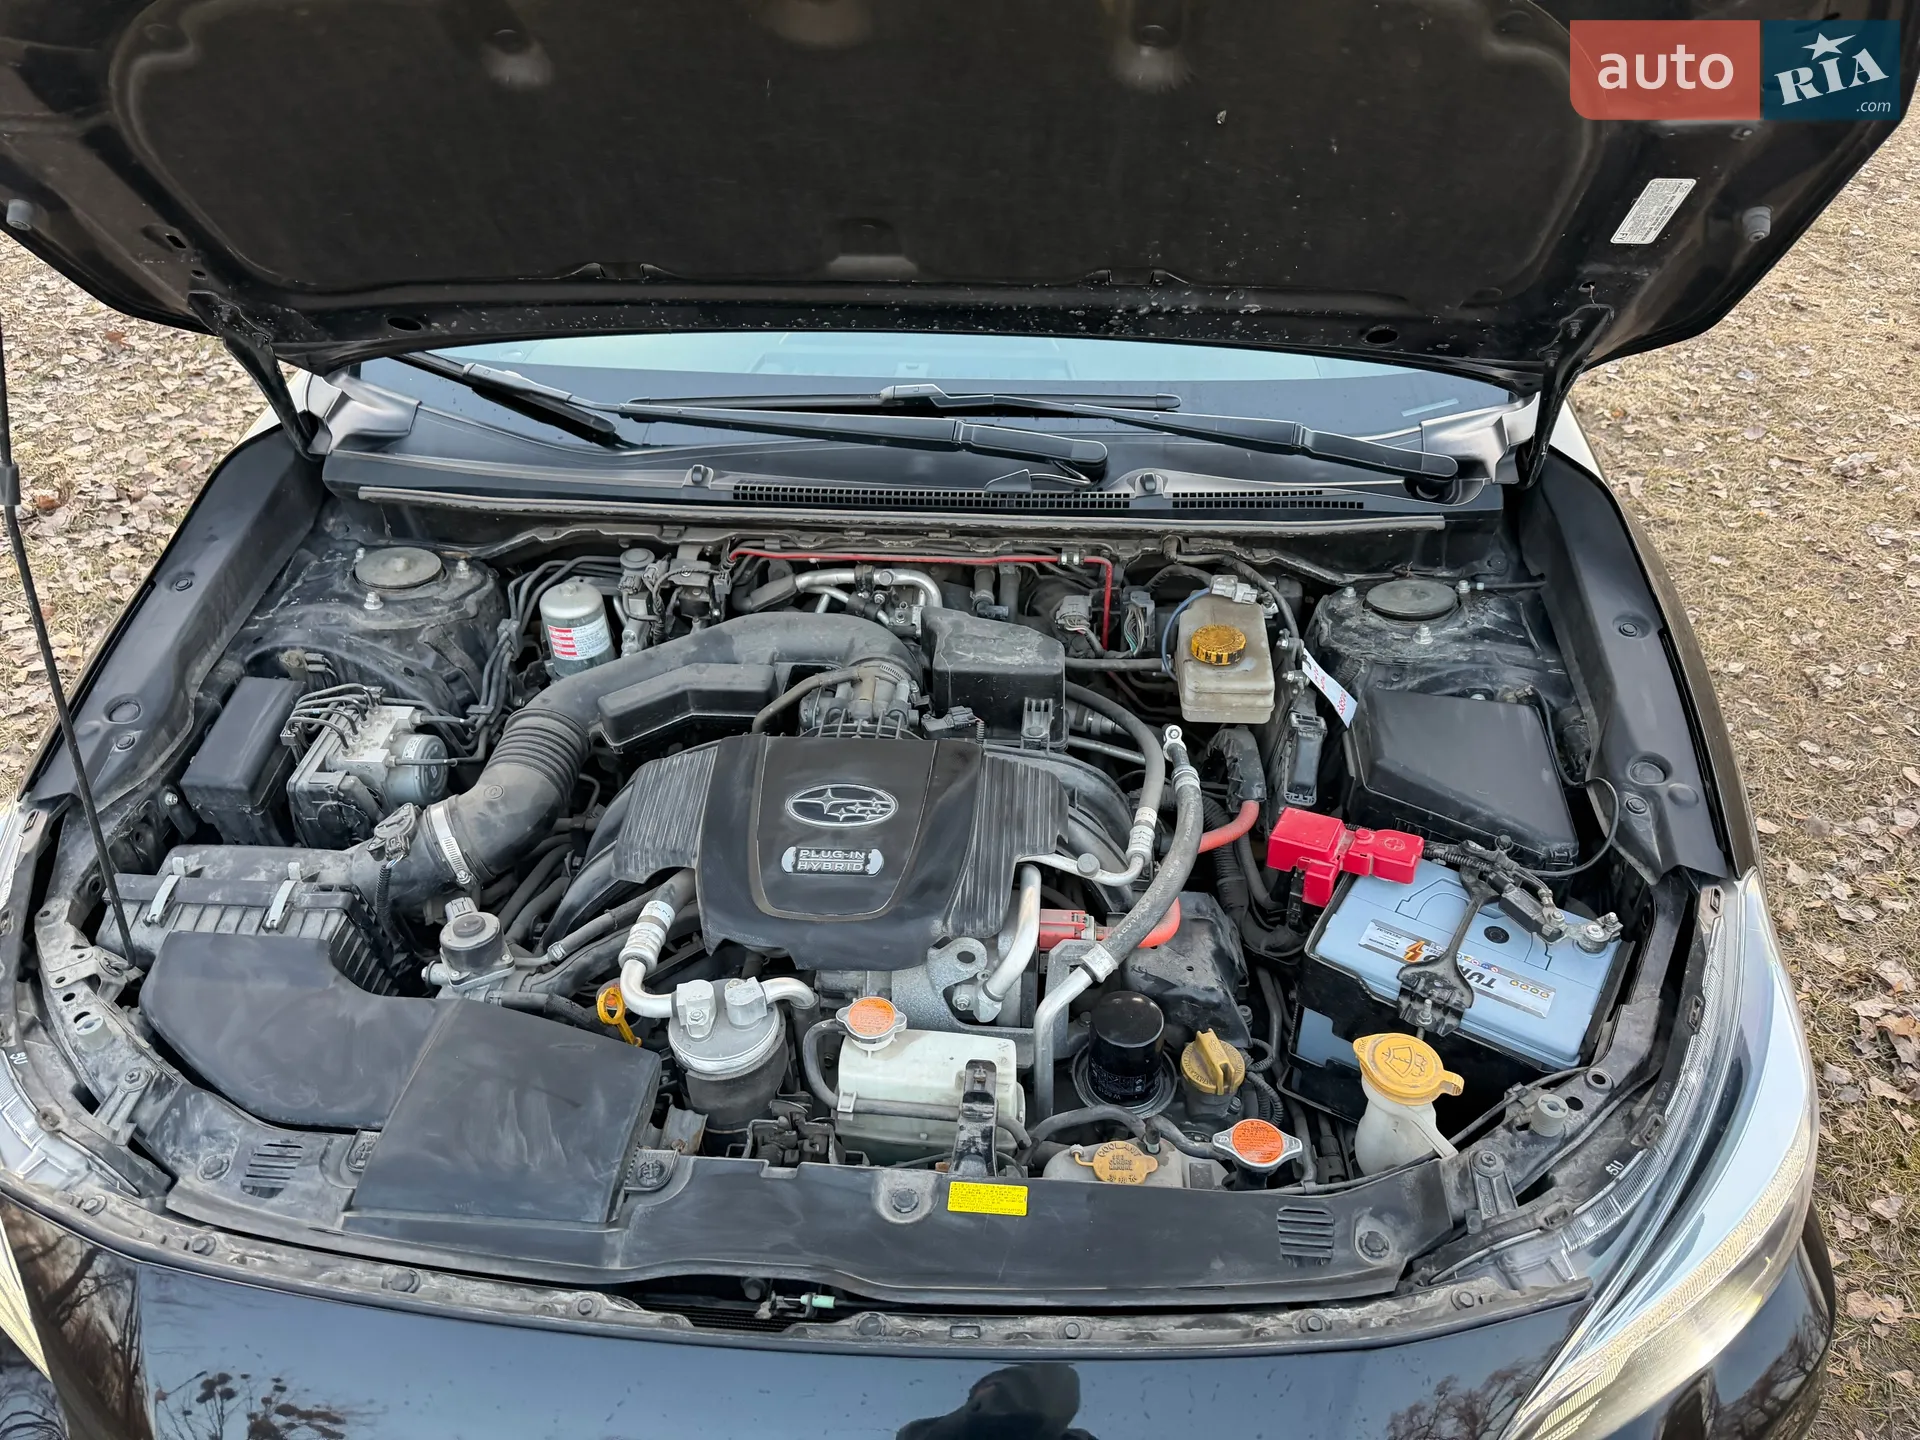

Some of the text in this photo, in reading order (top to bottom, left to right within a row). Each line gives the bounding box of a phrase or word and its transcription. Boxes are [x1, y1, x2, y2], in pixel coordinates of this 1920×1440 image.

[799, 849, 865, 859] PLUG-IN
[797, 861, 864, 871] HYBRID
[1097, 1142, 1142, 1157] COOLANT
